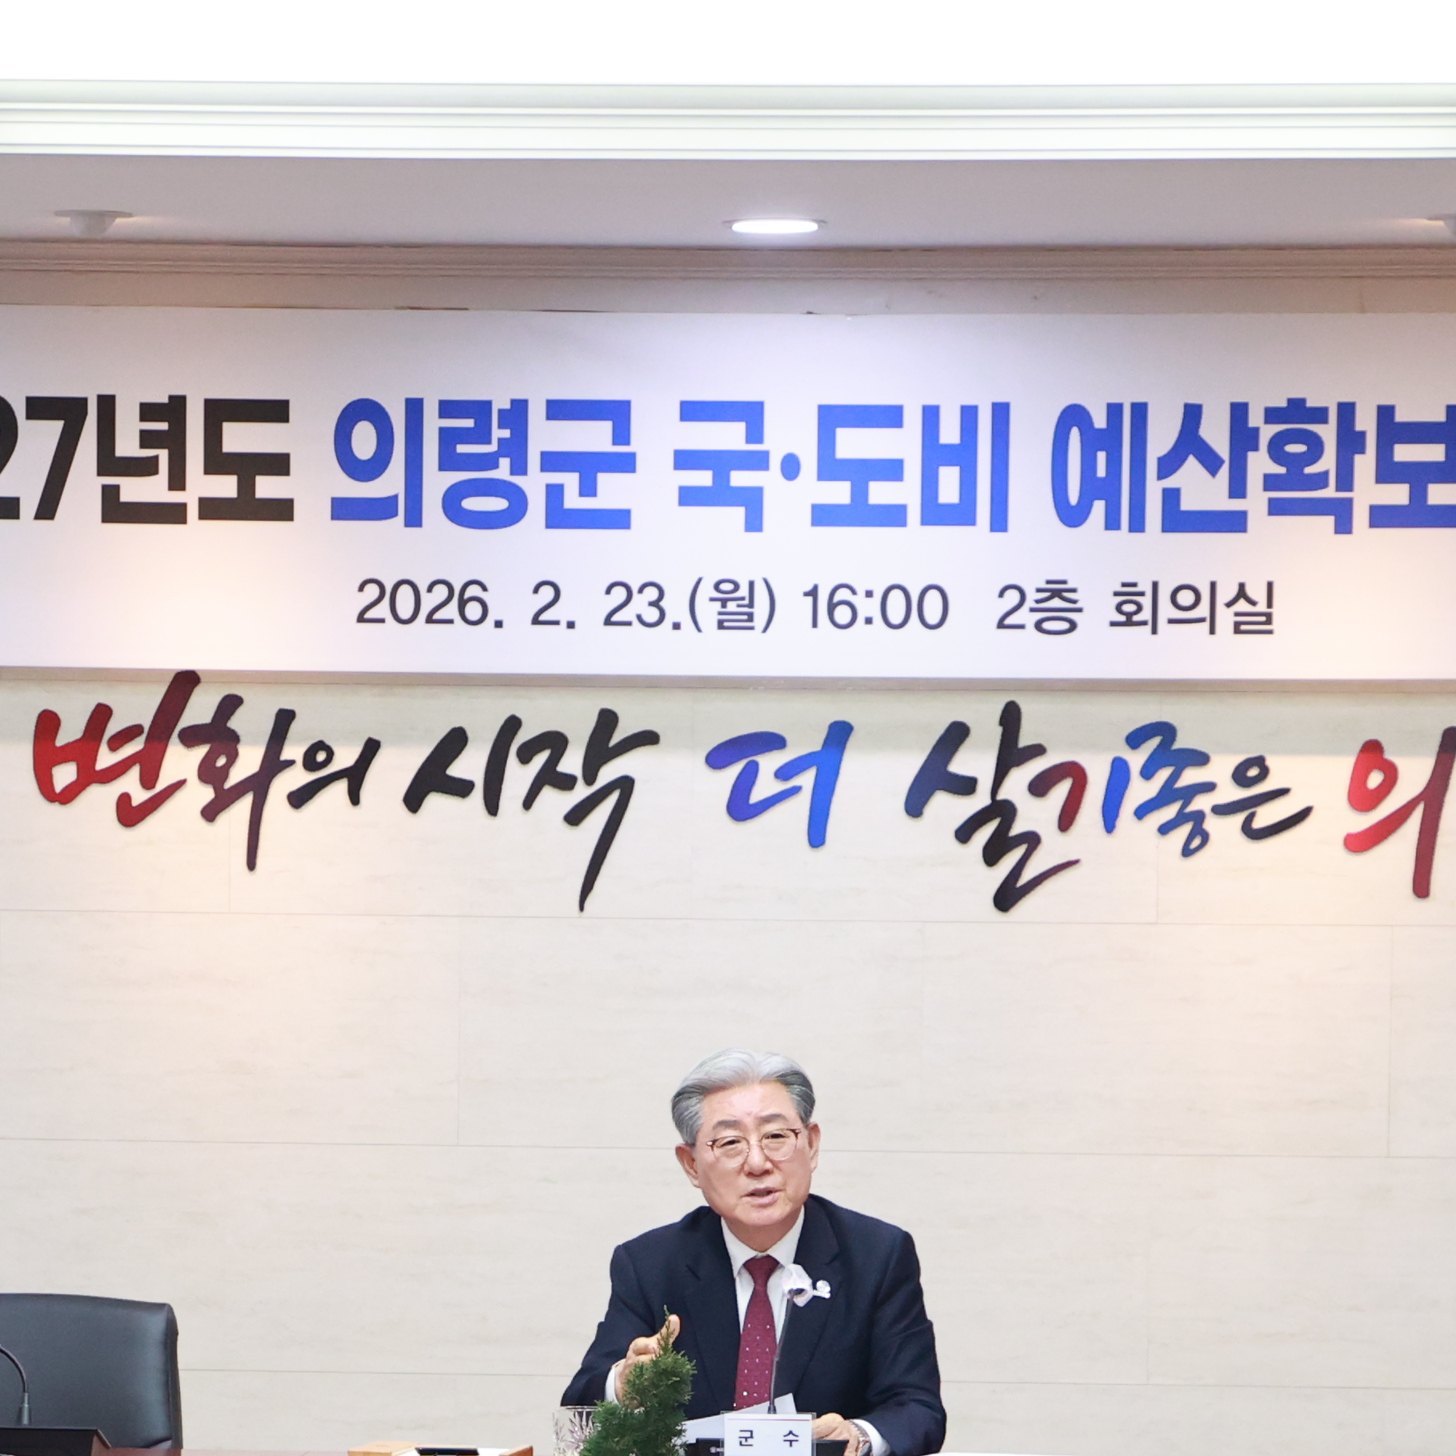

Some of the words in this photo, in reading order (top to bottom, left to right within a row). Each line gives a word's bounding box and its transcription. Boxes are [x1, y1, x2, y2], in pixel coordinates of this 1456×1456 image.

[331, 396, 637, 531] 의령군
[672, 400, 1010, 534] 국·도비
[356, 578, 504, 629] 2026.
[530, 580, 576, 630] 2.
[603, 577, 777, 634] 23.(월)
[803, 583, 950, 631] 16:00
[996, 579, 1085, 635] 2층
[1109, 580, 1275, 635] 회의실
[32, 670, 381, 872] 변화의
[403, 708, 661, 912] 시작
[704, 720, 855, 850] 더
[905, 700, 1314, 913] 살기좋은
[738, 1429, 754, 1447] 군
[782, 1430, 799, 1448] 수
